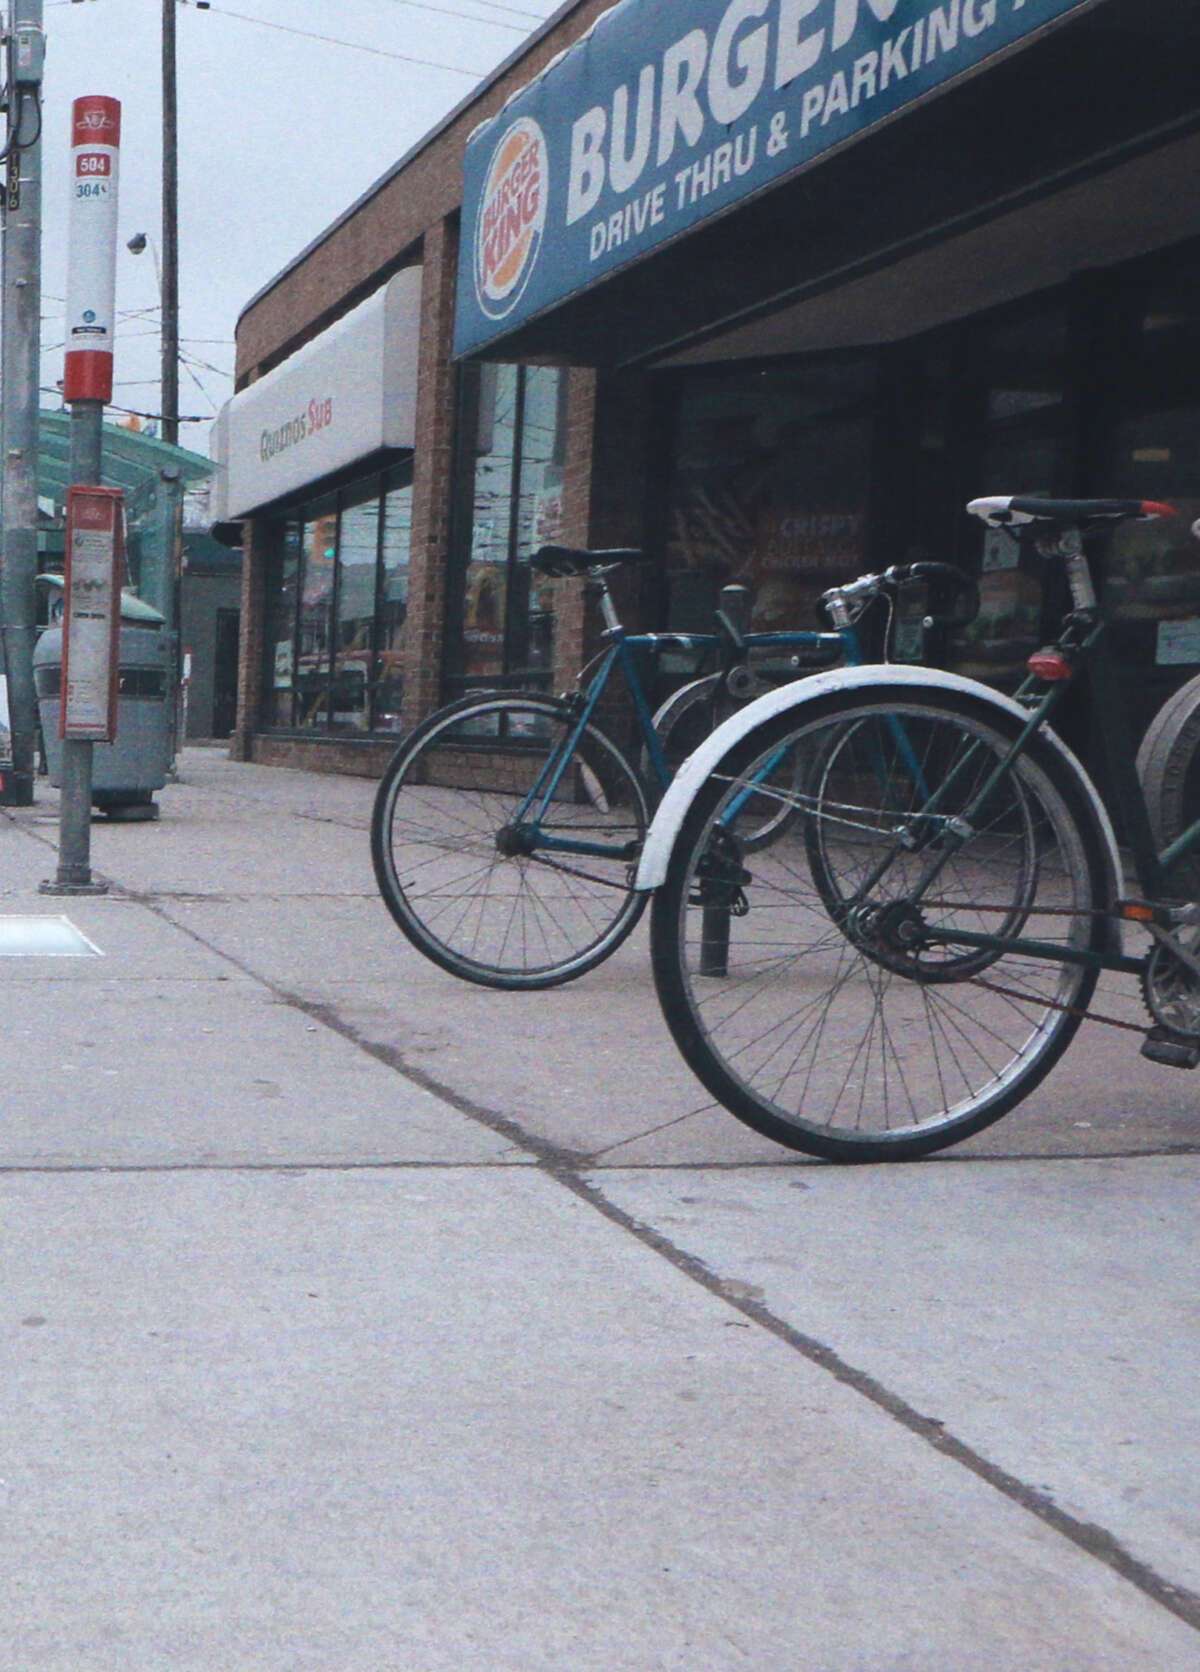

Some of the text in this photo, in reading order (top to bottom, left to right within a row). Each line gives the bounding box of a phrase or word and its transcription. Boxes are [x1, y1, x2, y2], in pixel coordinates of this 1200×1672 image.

[80, 157, 106, 173] 504
[588, 0, 997, 263] DRIVE THRU & PARKING
[75, 183, 100, 198] 304
[482, 138, 540, 244] BURGER
[482, 170, 541, 290] KING
